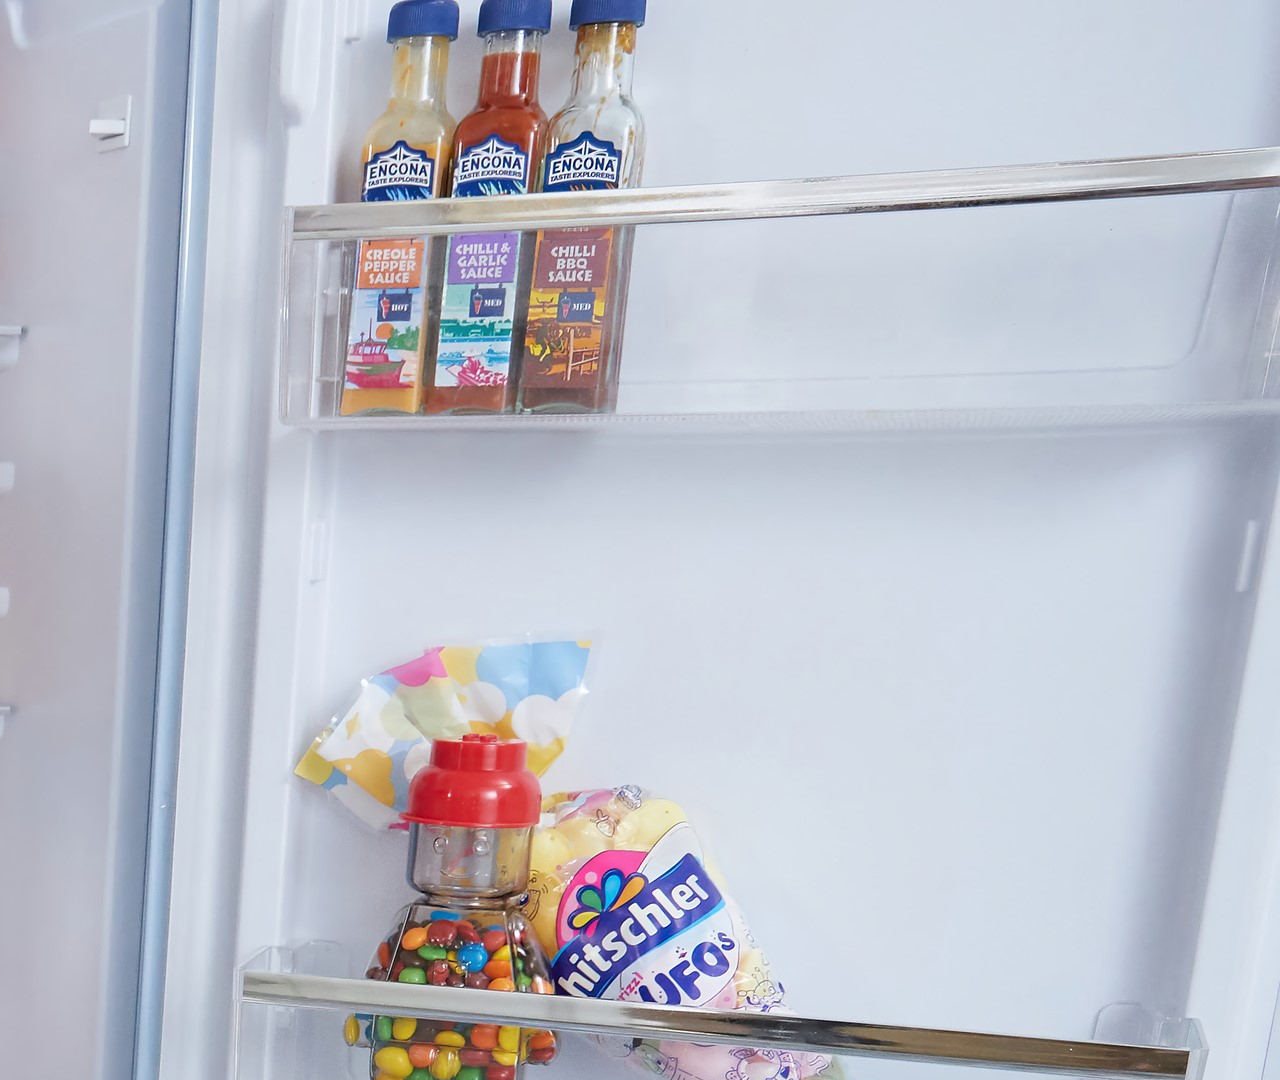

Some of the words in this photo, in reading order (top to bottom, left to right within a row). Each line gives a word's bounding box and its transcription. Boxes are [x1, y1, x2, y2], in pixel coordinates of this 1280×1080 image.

[461, 156, 521, 173] ENCONA
[552, 157, 614, 174] ENCONA
[370, 163, 427, 179] ENCONA
[460, 171, 480, 180] TASTE
[481, 169, 522, 178] EXPLORERS
[550, 173, 572, 182] TASTE
[572, 171, 615, 180] EXPLORERS
[368, 178, 387, 187] TASTE
[389, 176, 428, 184] EXPLORERS
[366, 248, 417, 260] CREOLE
[455, 243, 498, 255] CHILLI
[500, 242, 511, 253] &
[550, 245, 596, 257] CHILLI
[364, 260, 416, 272] PEPPER
[457, 254, 508, 267] GARLIC
[556, 258, 588, 269] BBQ
[369, 272, 410, 284] SAUCE
[460, 267, 502, 279] SAUCE
[548, 270, 593, 282] SAUCE
[571, 303, 591, 311] MED
[558, 874, 709, 998] hitschler
[639, 932, 736, 1005] UFOs
[617, 971, 644, 1001] rizzl
